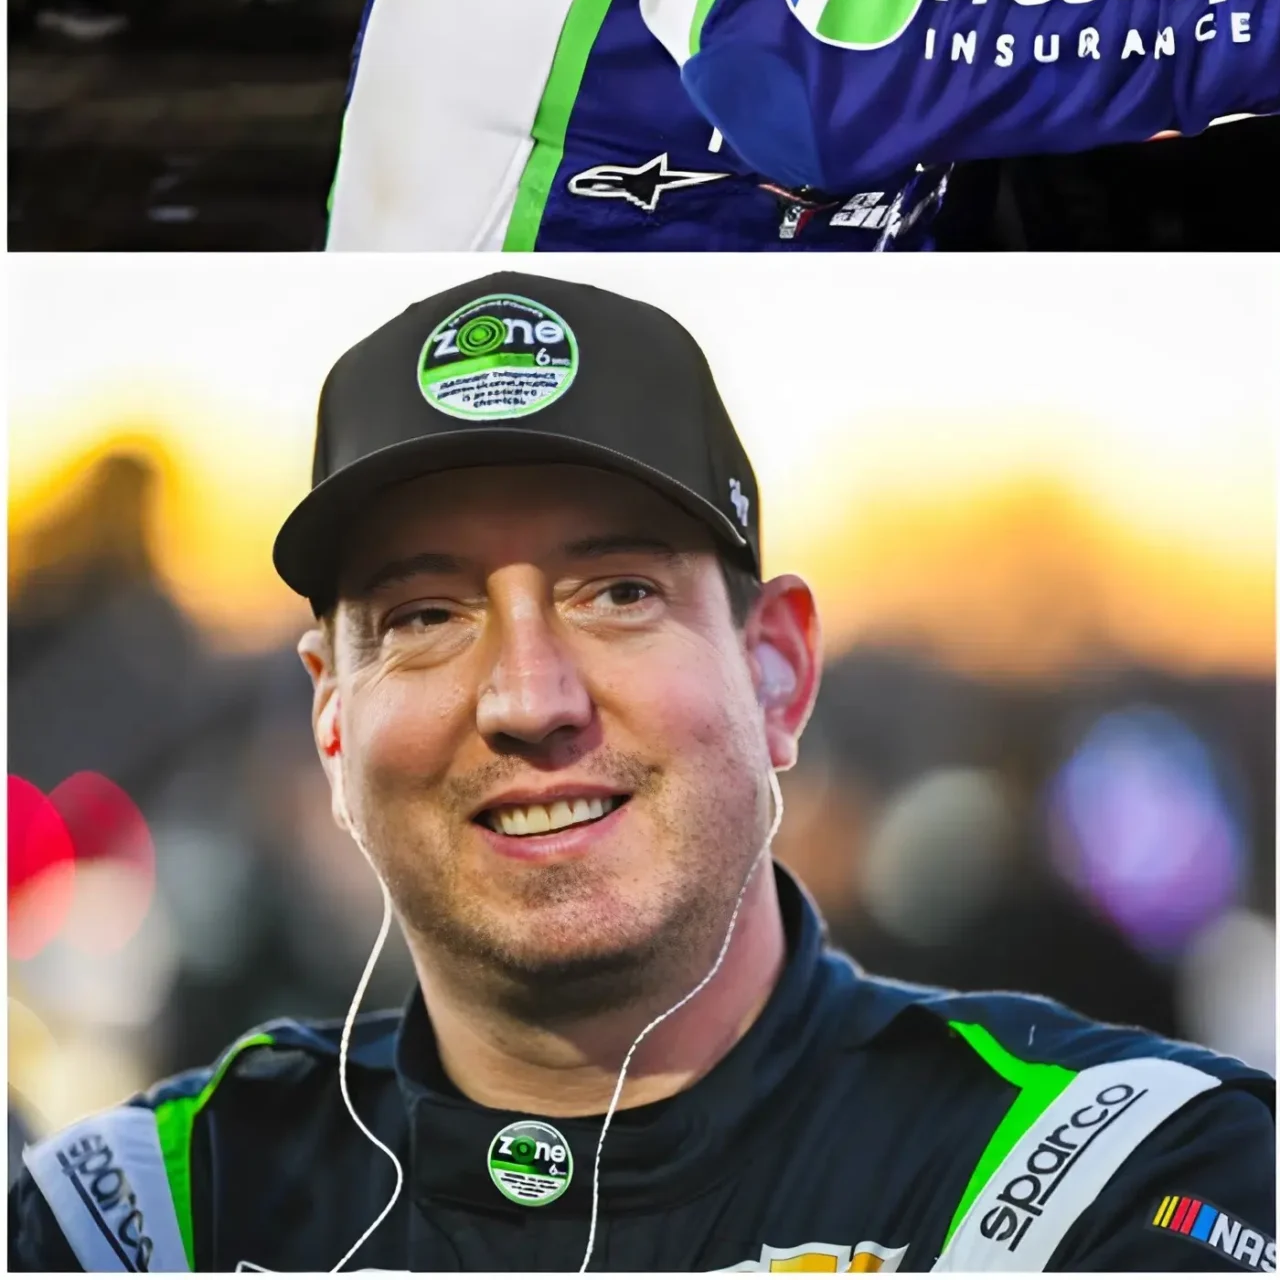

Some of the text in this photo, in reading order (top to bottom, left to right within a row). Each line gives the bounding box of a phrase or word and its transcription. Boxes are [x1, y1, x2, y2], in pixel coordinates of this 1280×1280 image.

[924, 11, 1252, 67] INSURANCE
[433, 316, 565, 359] zone
[535, 347, 550, 366] 6
[498, 1135, 567, 1163] zone
[979, 1083, 1135, 1242] sparco
